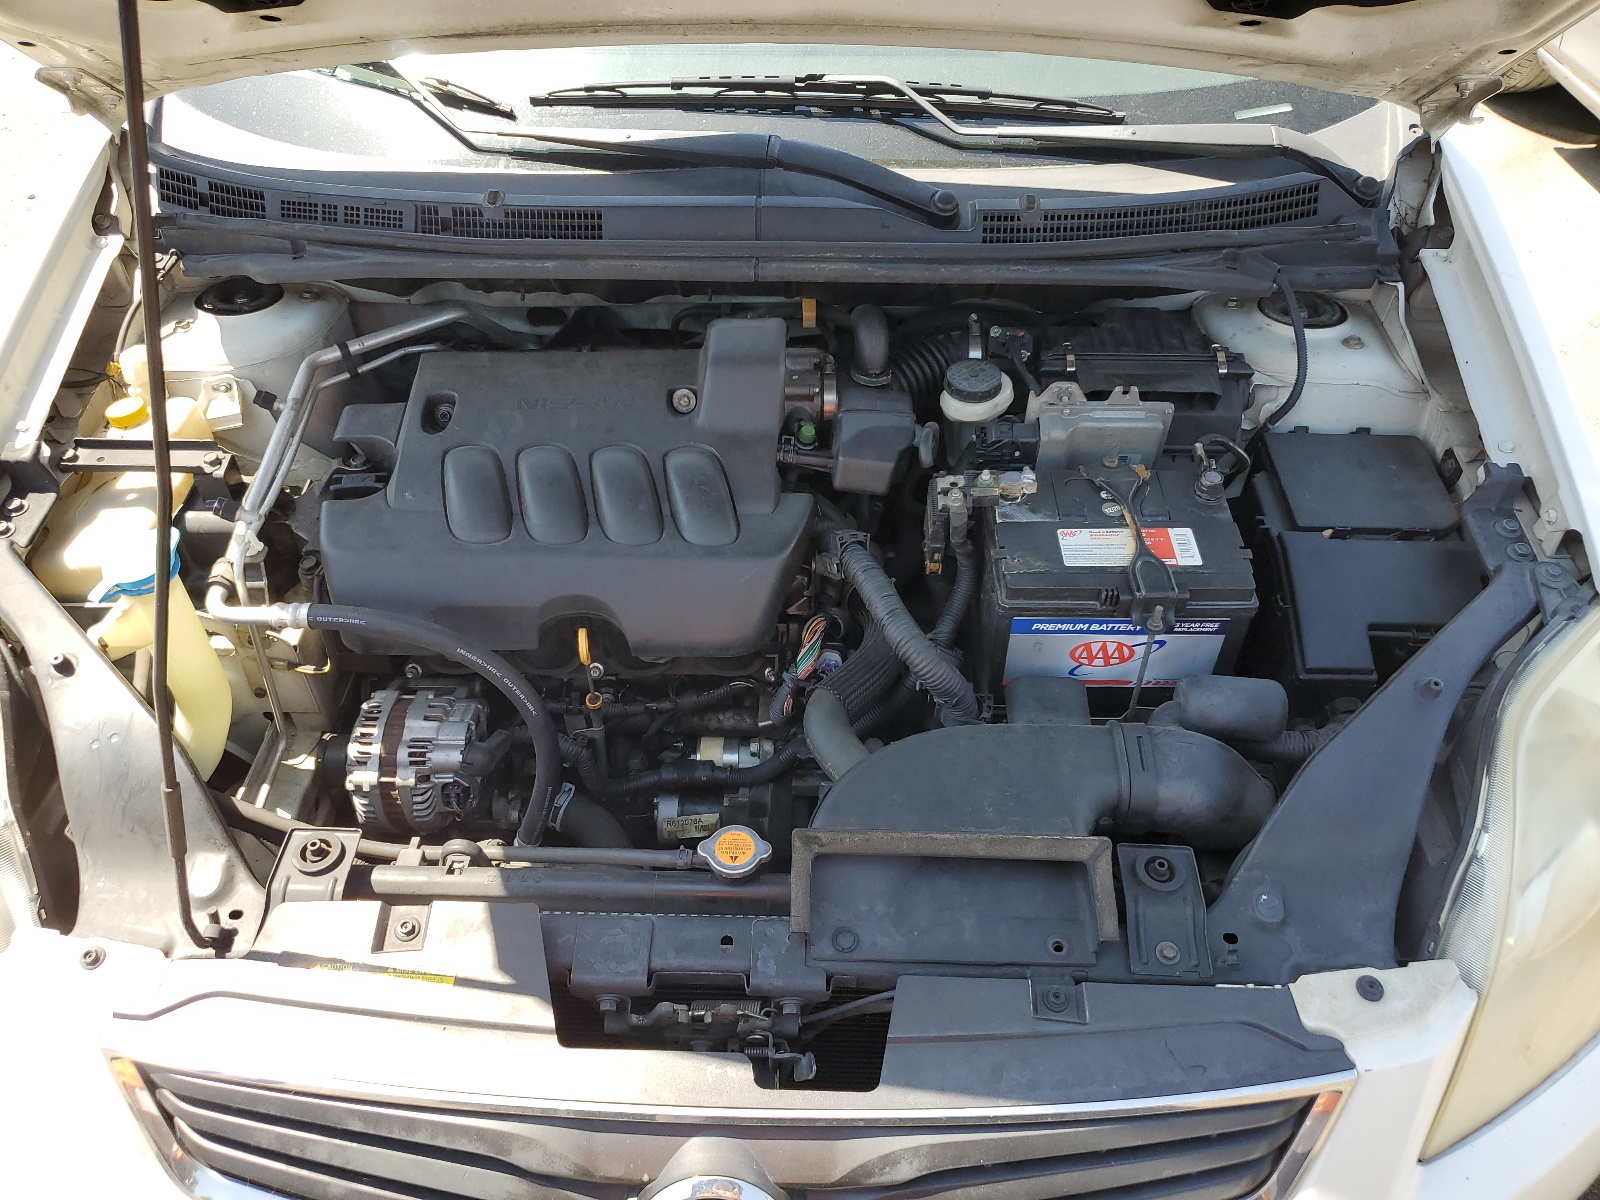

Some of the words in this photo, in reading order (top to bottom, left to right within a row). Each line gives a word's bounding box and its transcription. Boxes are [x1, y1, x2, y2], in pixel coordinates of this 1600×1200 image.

[1031, 623, 1088, 631] PREMIUM
[1074, 641, 1128, 667] AAA
[321, 963, 353, 971] CAUTION
